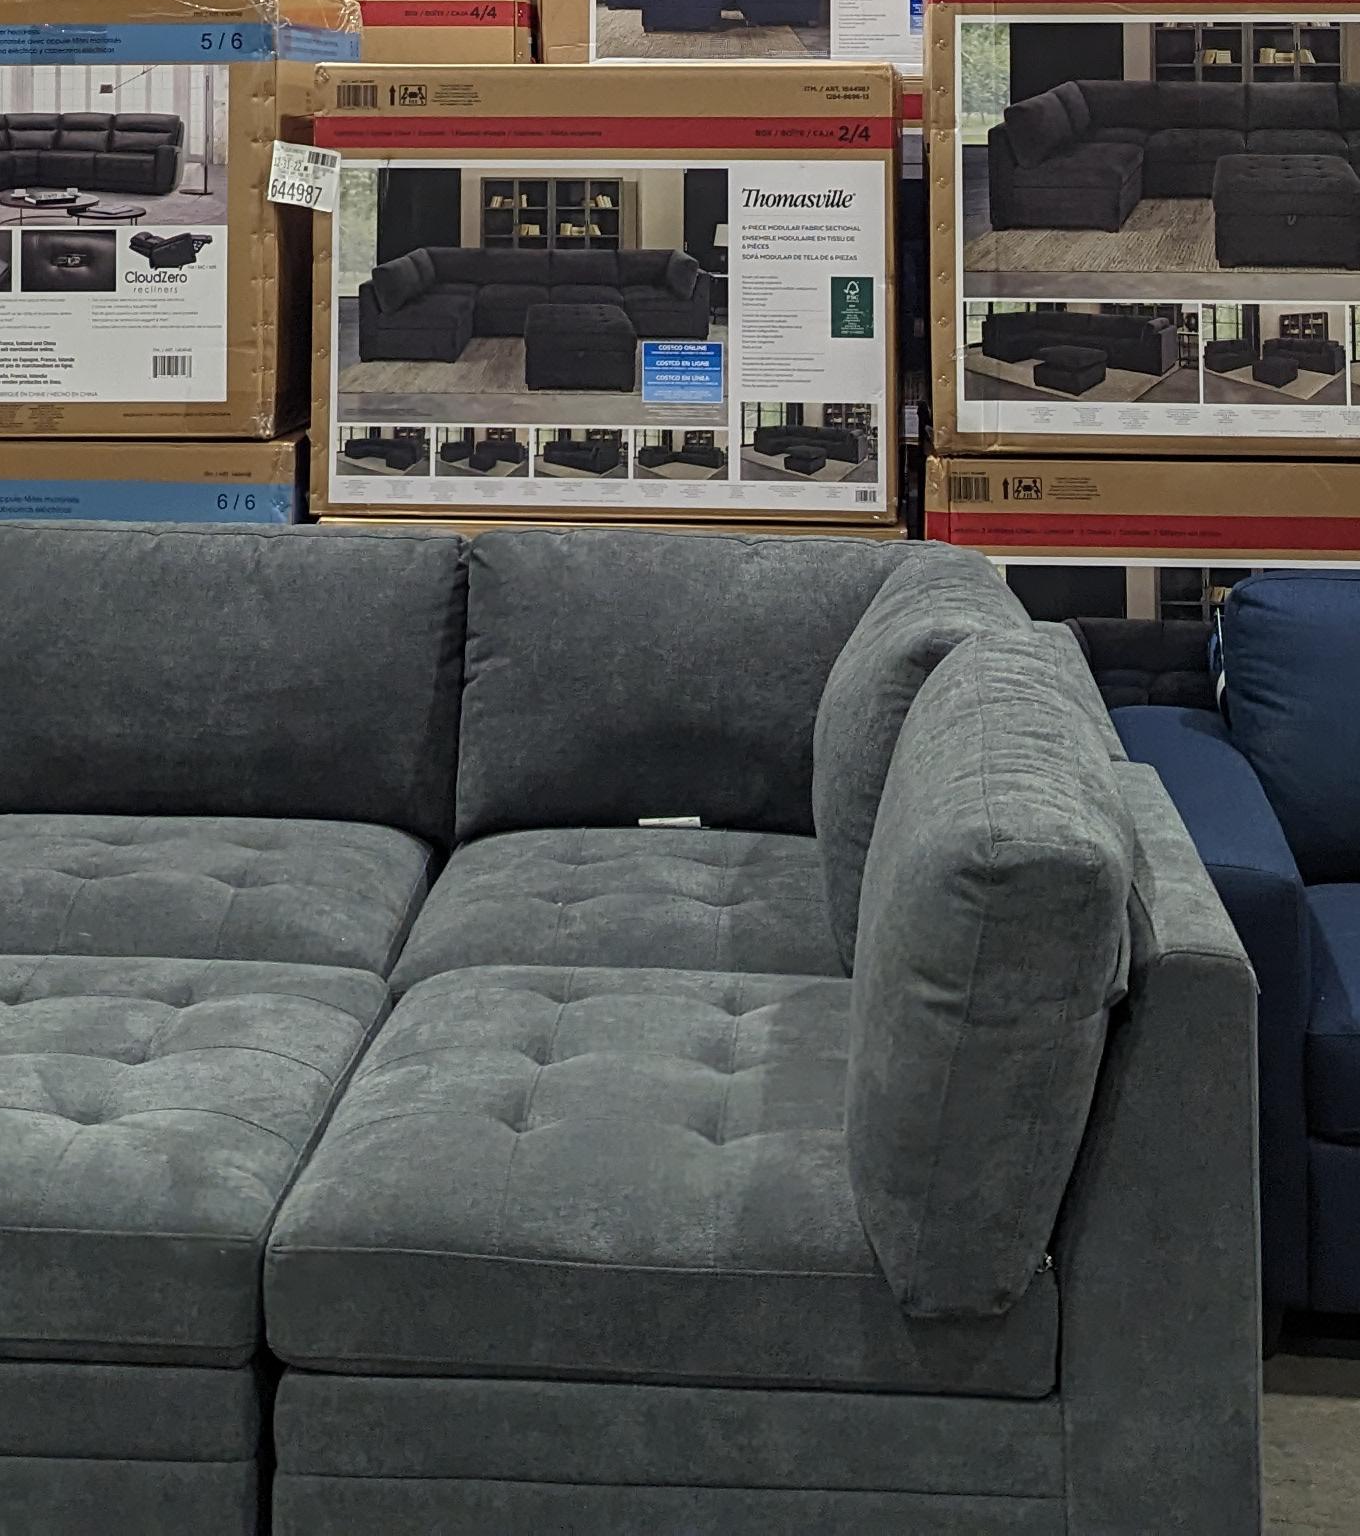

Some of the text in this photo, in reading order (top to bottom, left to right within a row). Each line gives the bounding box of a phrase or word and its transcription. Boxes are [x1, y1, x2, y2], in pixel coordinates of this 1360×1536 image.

[470, 4, 497, 21] 4/4
[200, 33, 212, 50] 5
[231, 32, 243, 50] 6
[838, 124, 871, 144] 2/4
[271, 178, 323, 206] 644987
[742, 188, 853, 208] Thomasville
[125, 271, 188, 283] CloudZero
[134, 286, 178, 294] recliners
[217, 494, 228, 510] 6
[245, 494, 256, 510] 6
